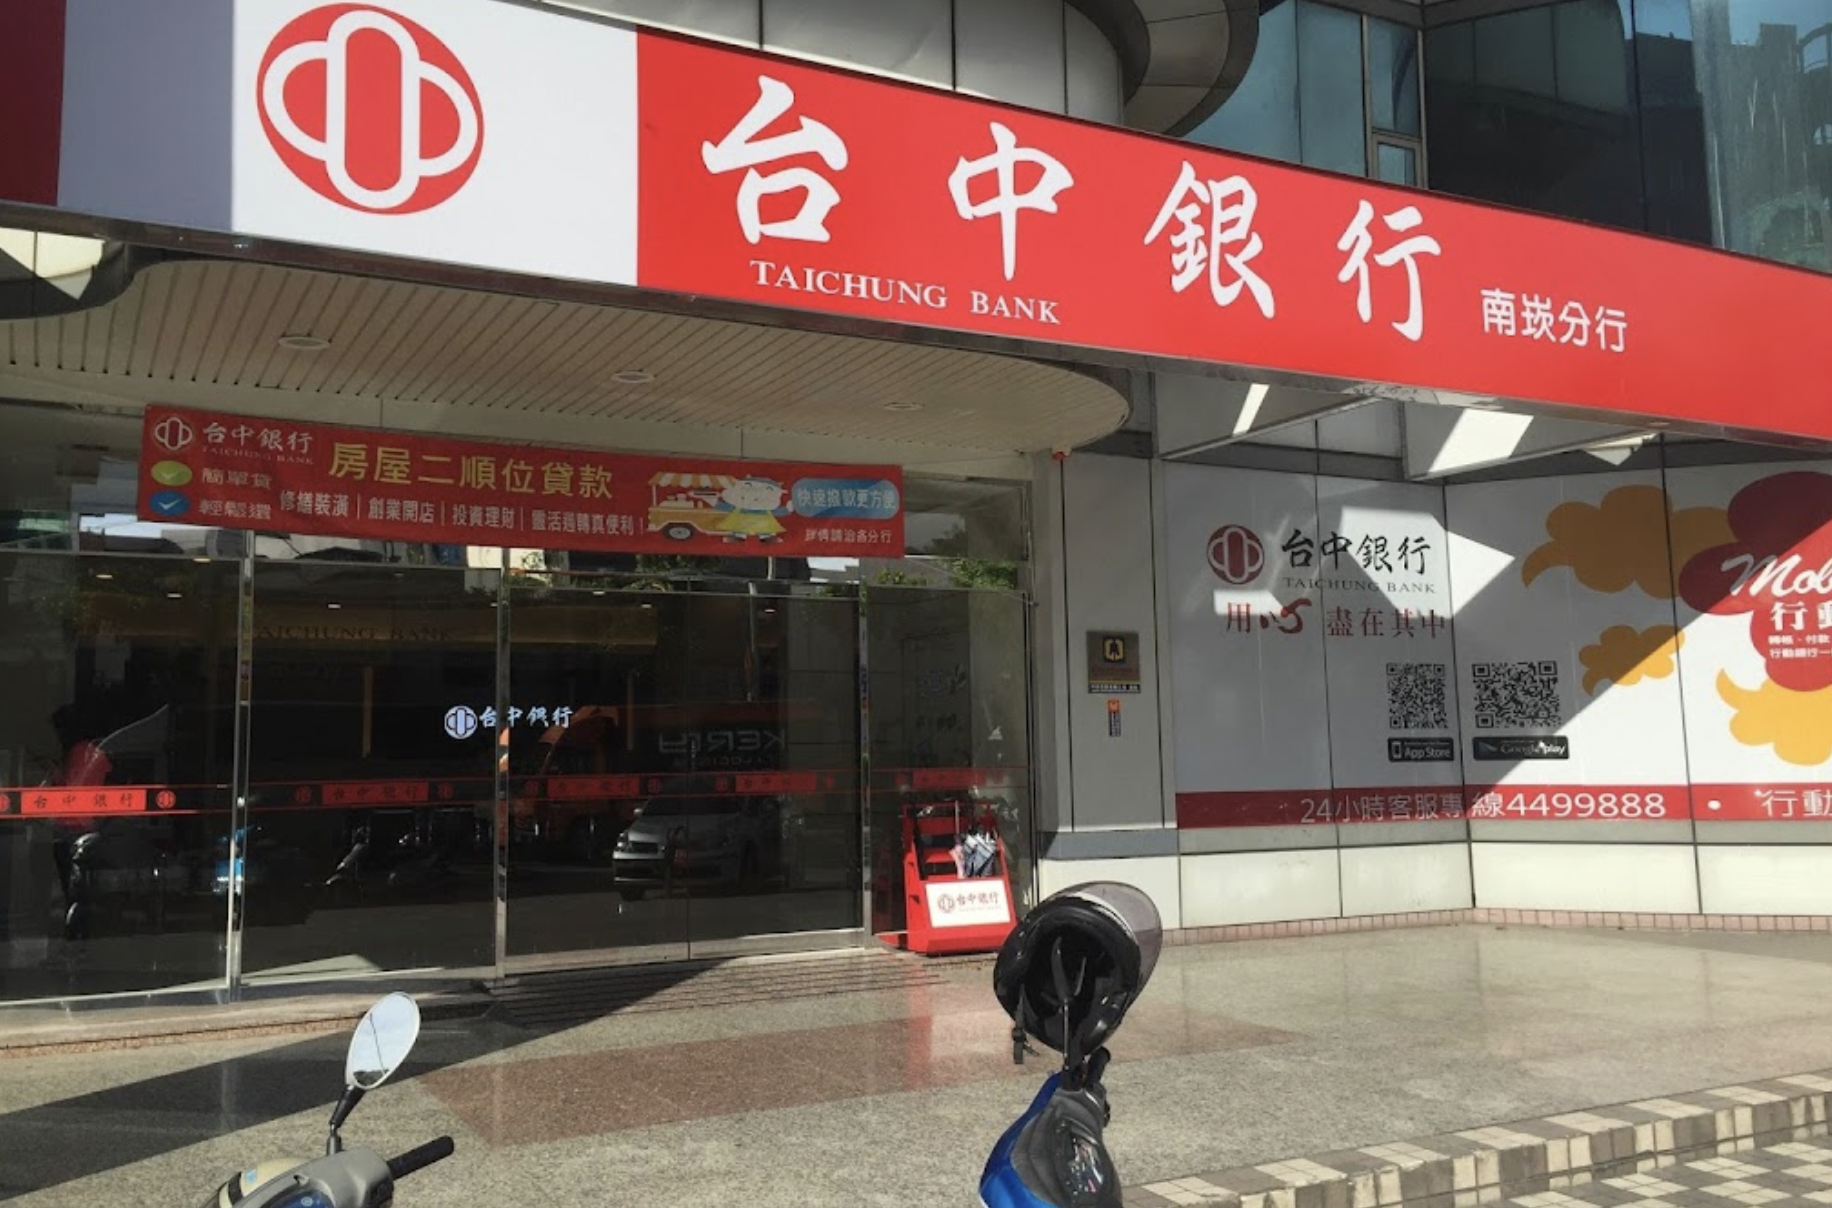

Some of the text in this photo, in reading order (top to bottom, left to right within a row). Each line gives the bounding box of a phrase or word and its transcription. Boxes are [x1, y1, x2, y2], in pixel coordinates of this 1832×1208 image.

[702, 75, 1441, 341] 台中銀行
[750, 260, 1060, 325] TAICHUNG BANK
[1480, 288, 1627, 352] 南崁分行
[202, 422, 313, 454] 台中銀行
[329, 442, 613, 499] 房屋二順位貸款
[1282, 529, 1431, 575] 台中銀行
[1283, 576, 1436, 594] TAICHUNG BANK
[1327, 605, 1446, 638] 盡在其中
[1404, 746, 1450, 759] App Store
[34, 793, 133, 808] 台中銀行
[1300, 791, 1667, 823] 24小時客服專線4499888
[1761, 790, 1832, 818] 行動
